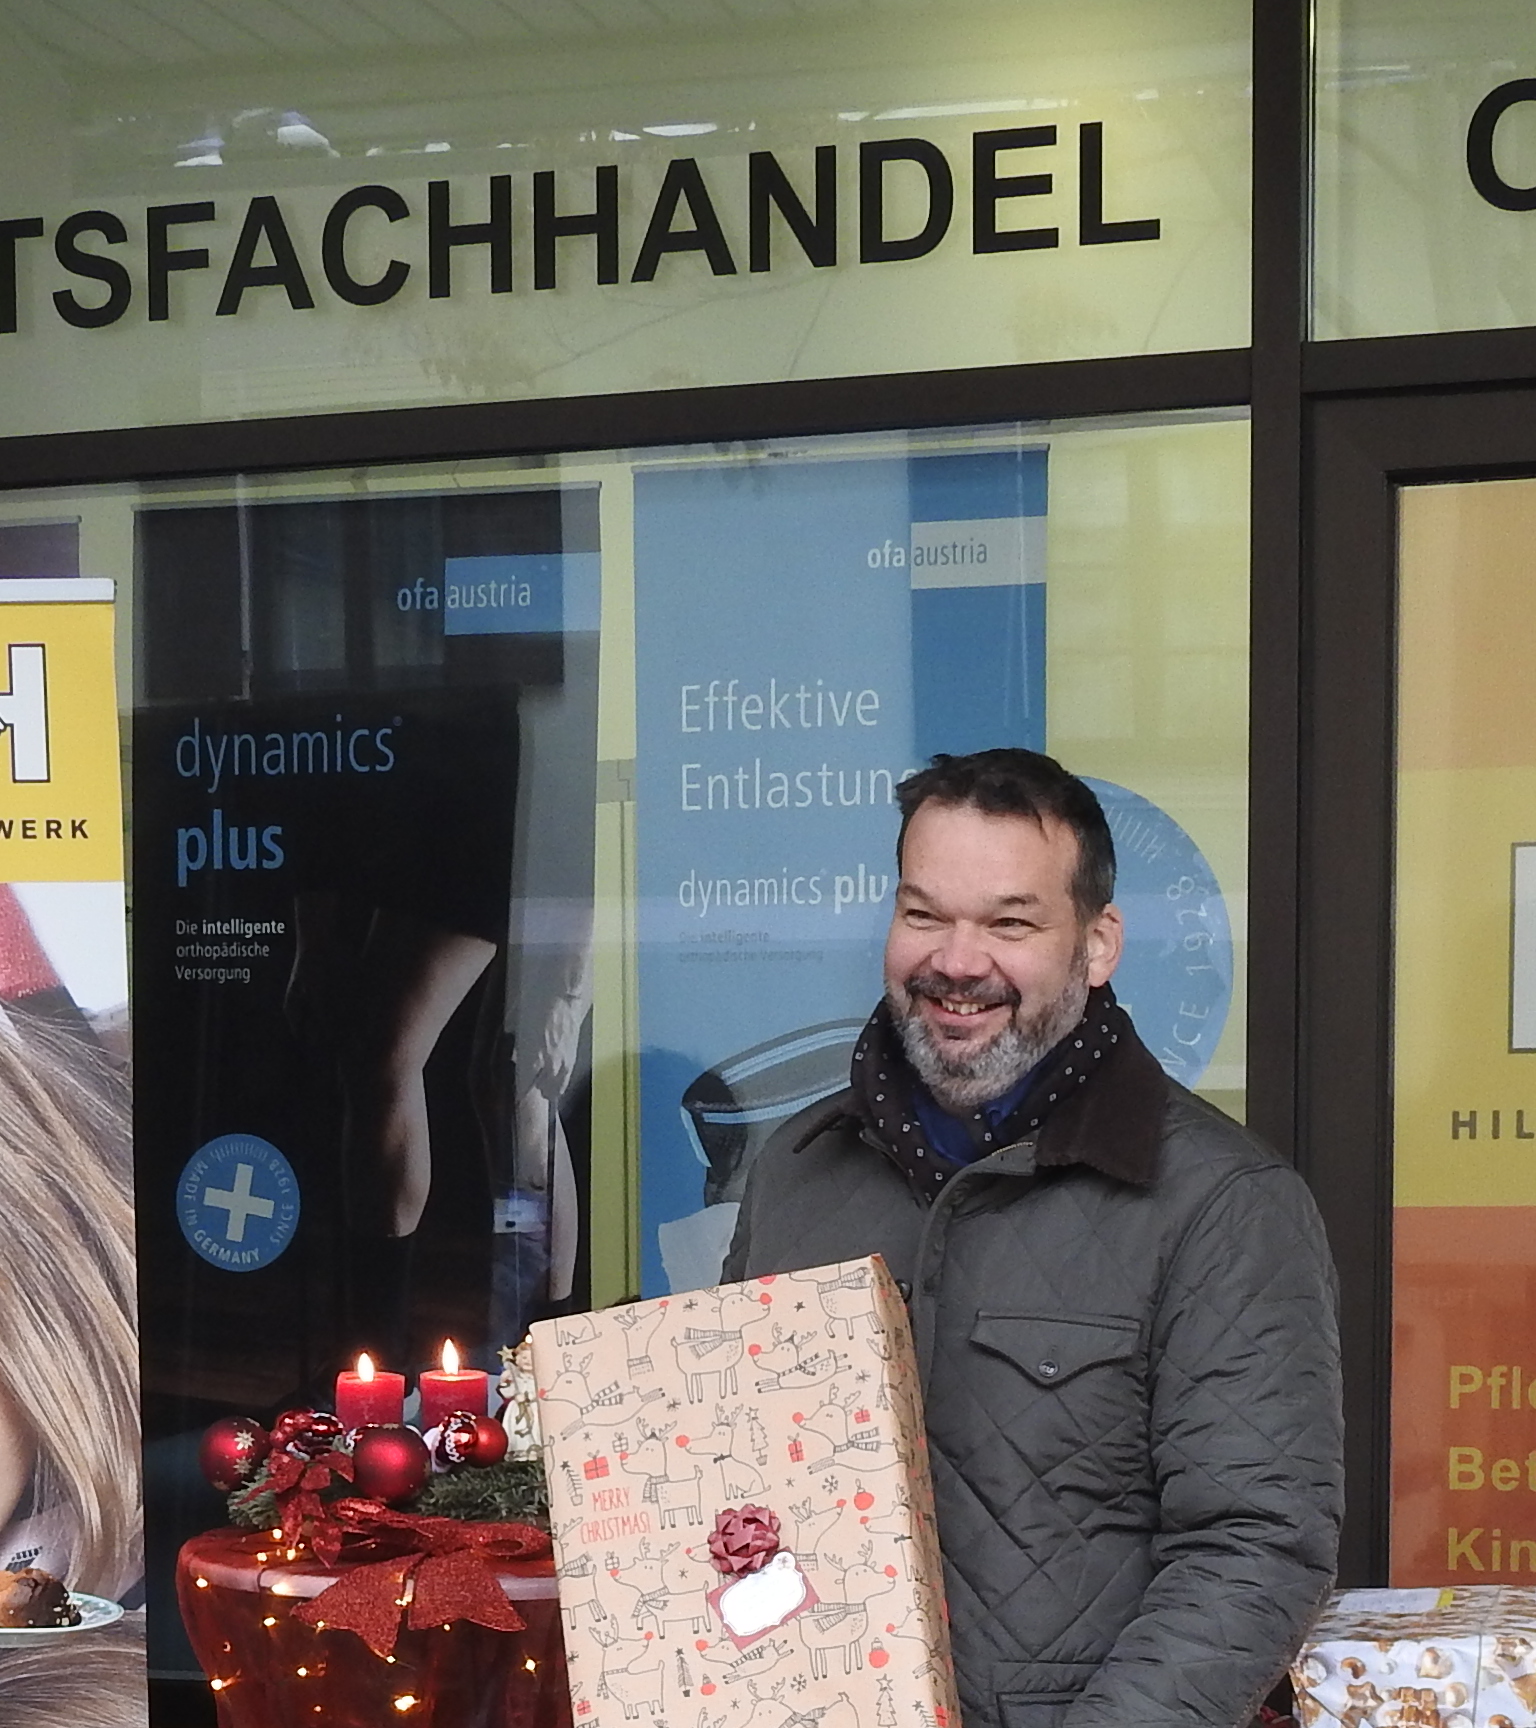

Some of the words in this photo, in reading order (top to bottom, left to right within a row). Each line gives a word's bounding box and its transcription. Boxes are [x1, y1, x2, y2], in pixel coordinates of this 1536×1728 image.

[867, 539, 906, 568] ofa
[913, 537, 989, 567] austria
[397, 577, 439, 611] ofa
[447, 575, 532, 610] austria
[680, 678, 880, 733] Effektive
[176, 808, 286, 887] plus
[834, 864, 889, 914] plu
[176, 919, 198, 935] Die
[202, 918, 285, 938] intelligente
[176, 941, 270, 960] orthopädische
[175, 965, 250, 984] Versorgung
[193, 1228, 260, 1264] GERMANY
[592, 1486, 631, 1512] MERRY
